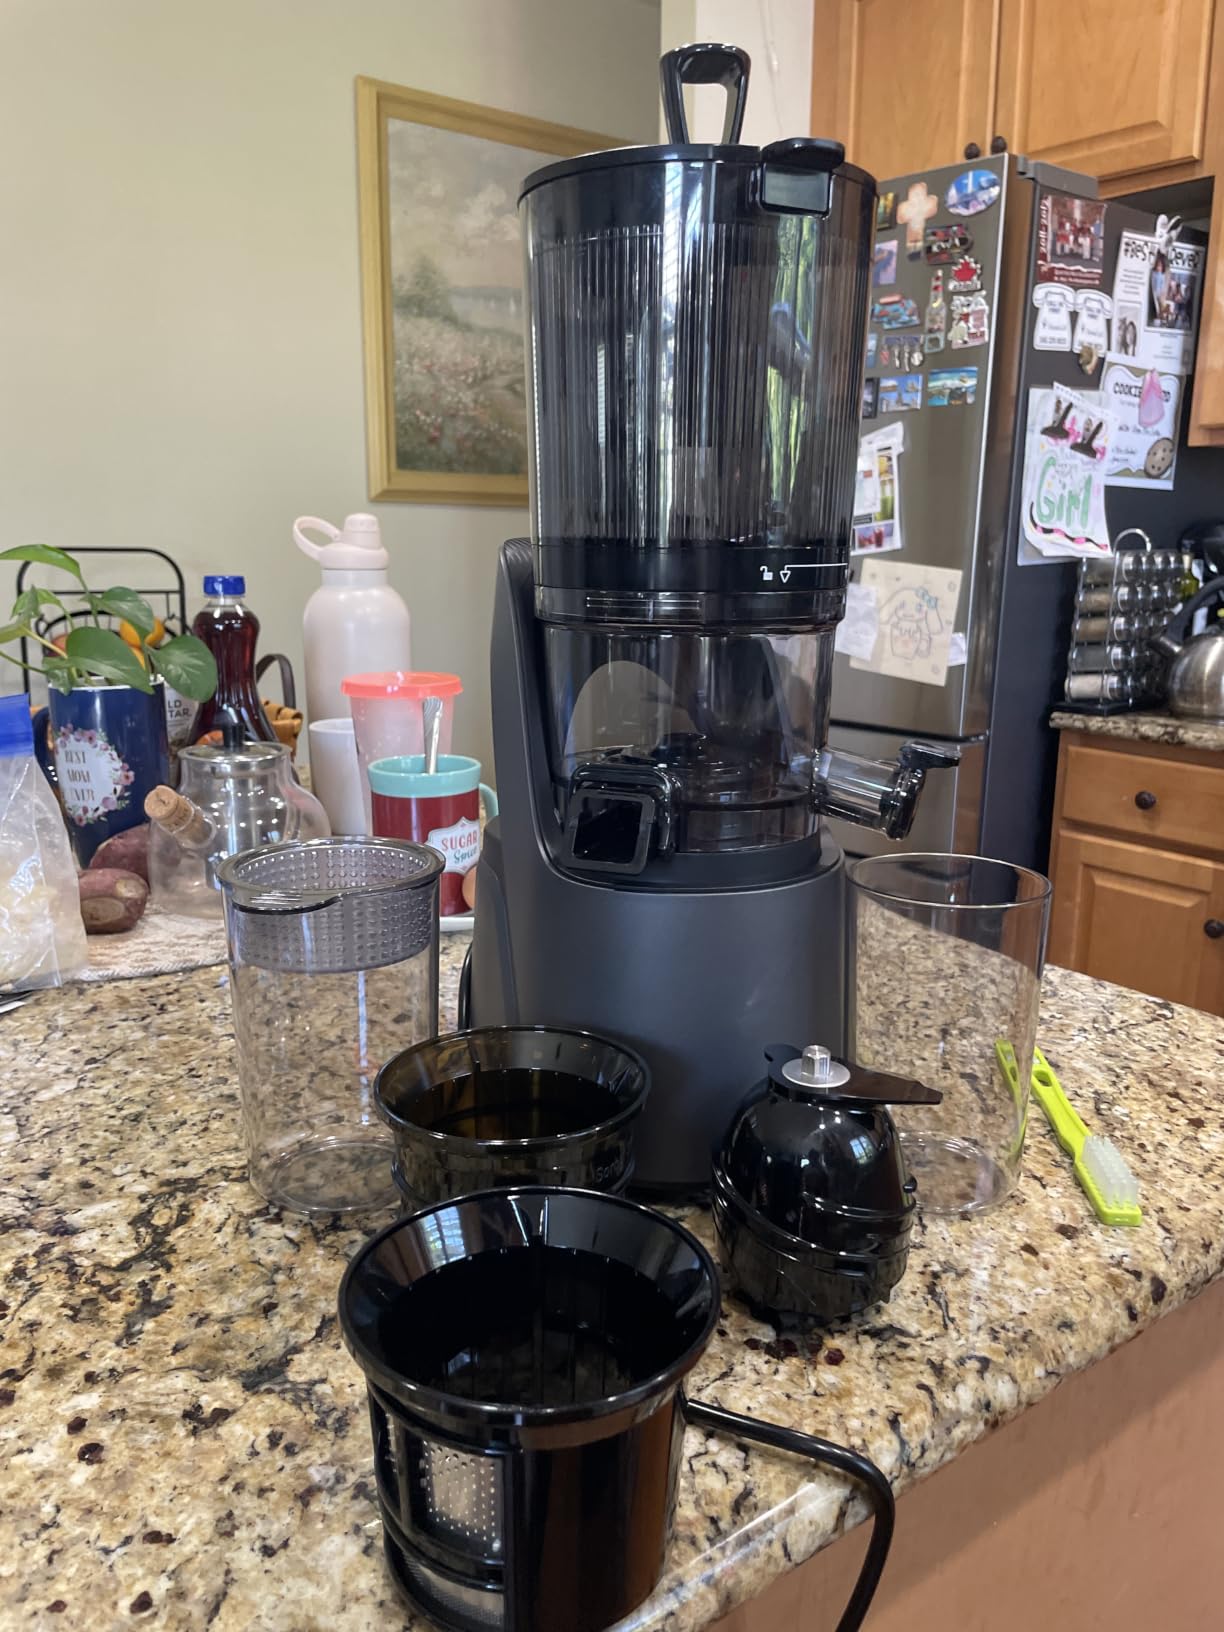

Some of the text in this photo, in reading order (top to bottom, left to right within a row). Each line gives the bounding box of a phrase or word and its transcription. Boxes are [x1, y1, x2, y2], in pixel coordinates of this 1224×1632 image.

[167, 699, 182, 709] LD
[167, 707, 193, 719] TAR.
[64, 750, 86, 764] BEST
[441, 830, 478, 852] SUGAR
